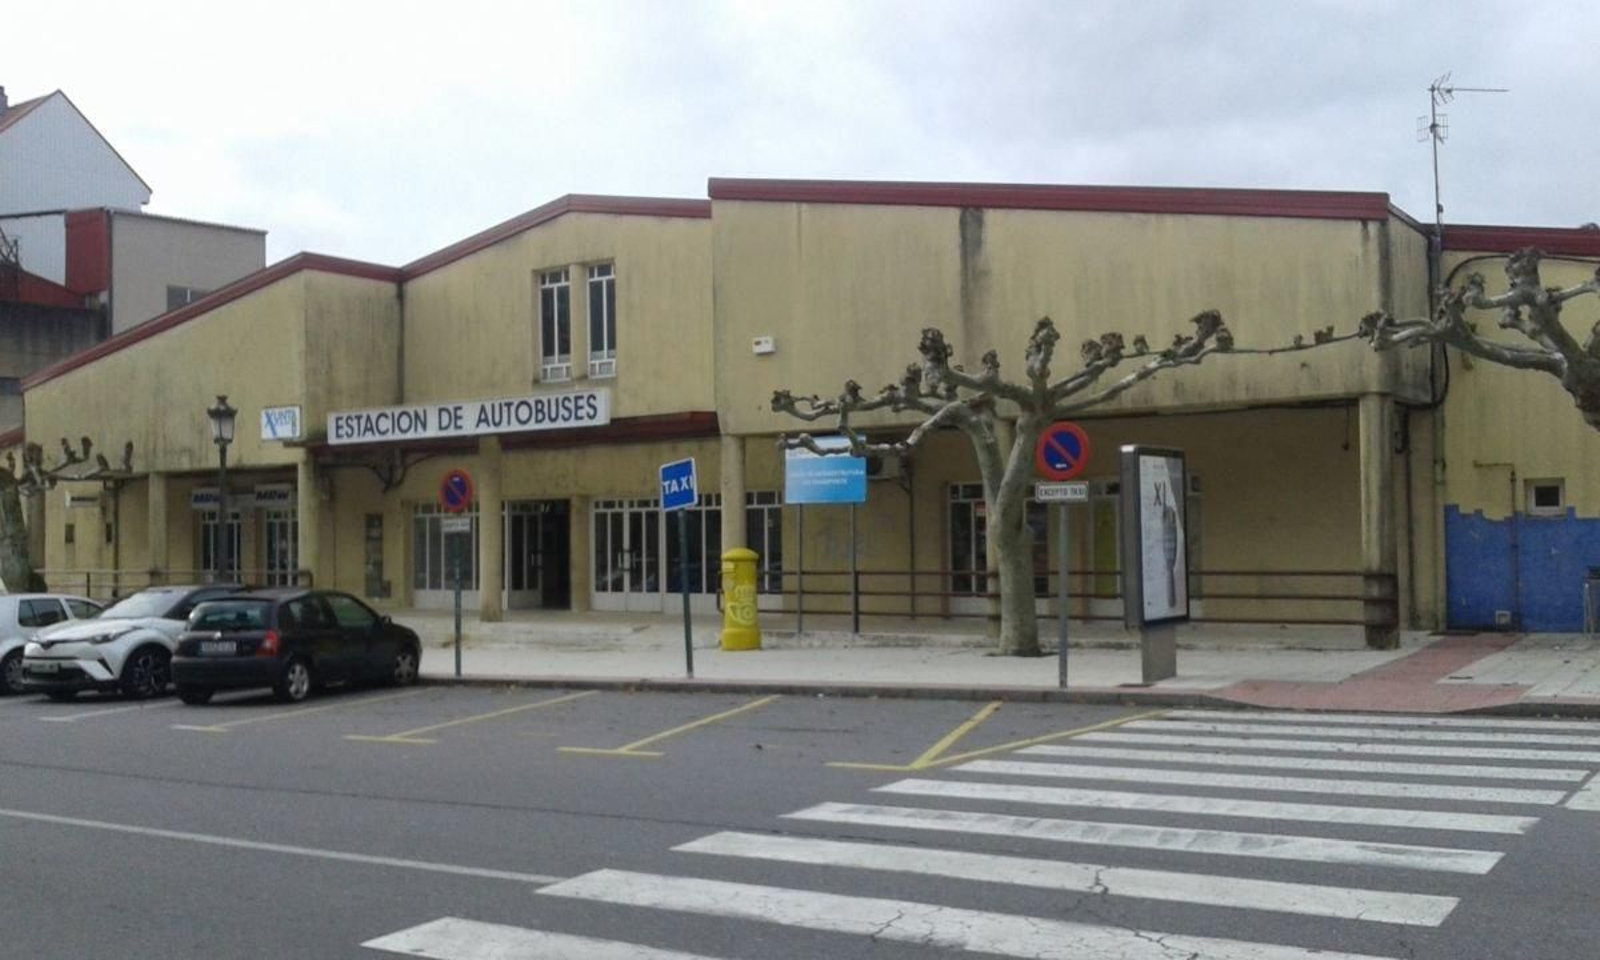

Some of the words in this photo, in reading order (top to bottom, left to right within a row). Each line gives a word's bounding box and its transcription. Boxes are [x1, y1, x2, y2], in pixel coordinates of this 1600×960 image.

[335, 408, 427, 439] ESTACION
[438, 406, 463, 431] DE
[476, 394, 598, 428] AUTOBUSES
[661, 475, 693, 495] TAXI
